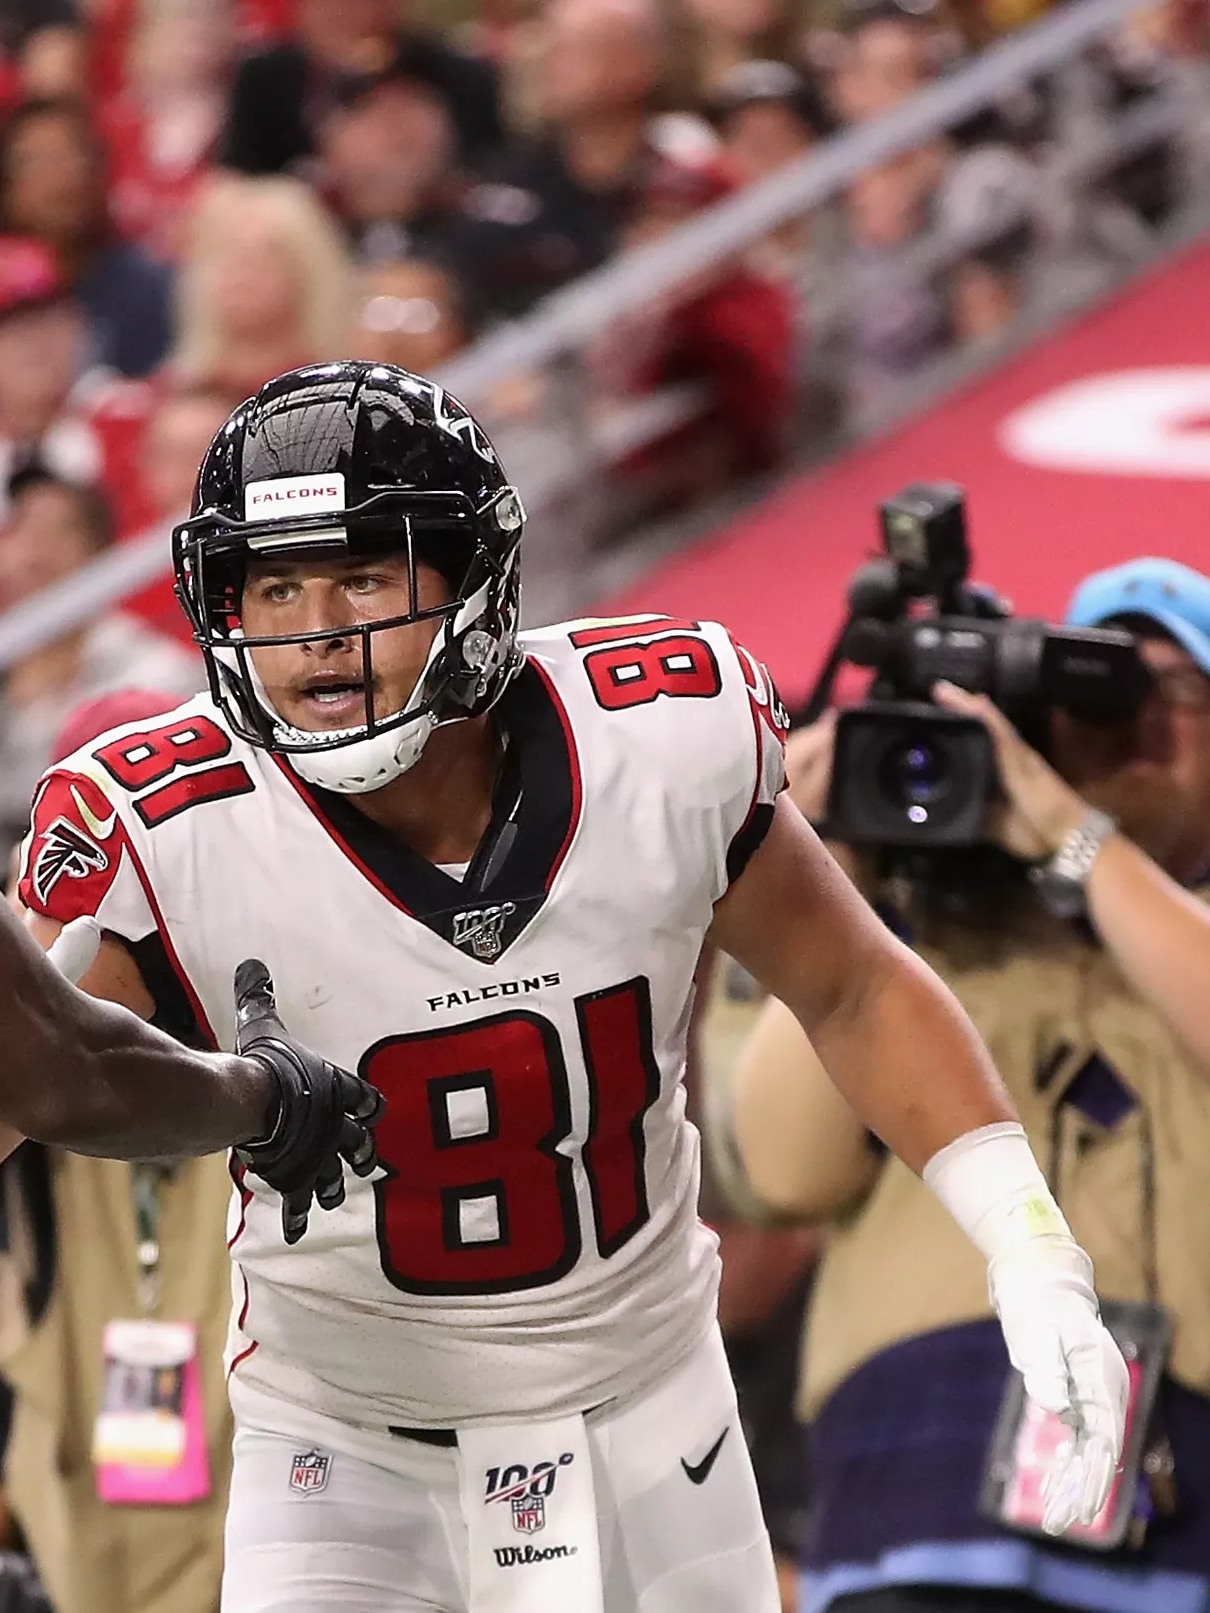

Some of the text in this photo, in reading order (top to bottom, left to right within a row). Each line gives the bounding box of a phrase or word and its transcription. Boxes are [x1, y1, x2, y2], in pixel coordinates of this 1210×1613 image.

[253, 486, 338, 504] FALCONS
[567, 618, 722, 711] 81
[91, 715, 256, 829] 81
[426, 972, 561, 1011] FALCONS
[357, 975, 661, 1296] 81
[293, 1469, 321, 1488] NFL
[516, 1512, 543, 1530] NFL
[494, 1545, 568, 1567] Wilson
